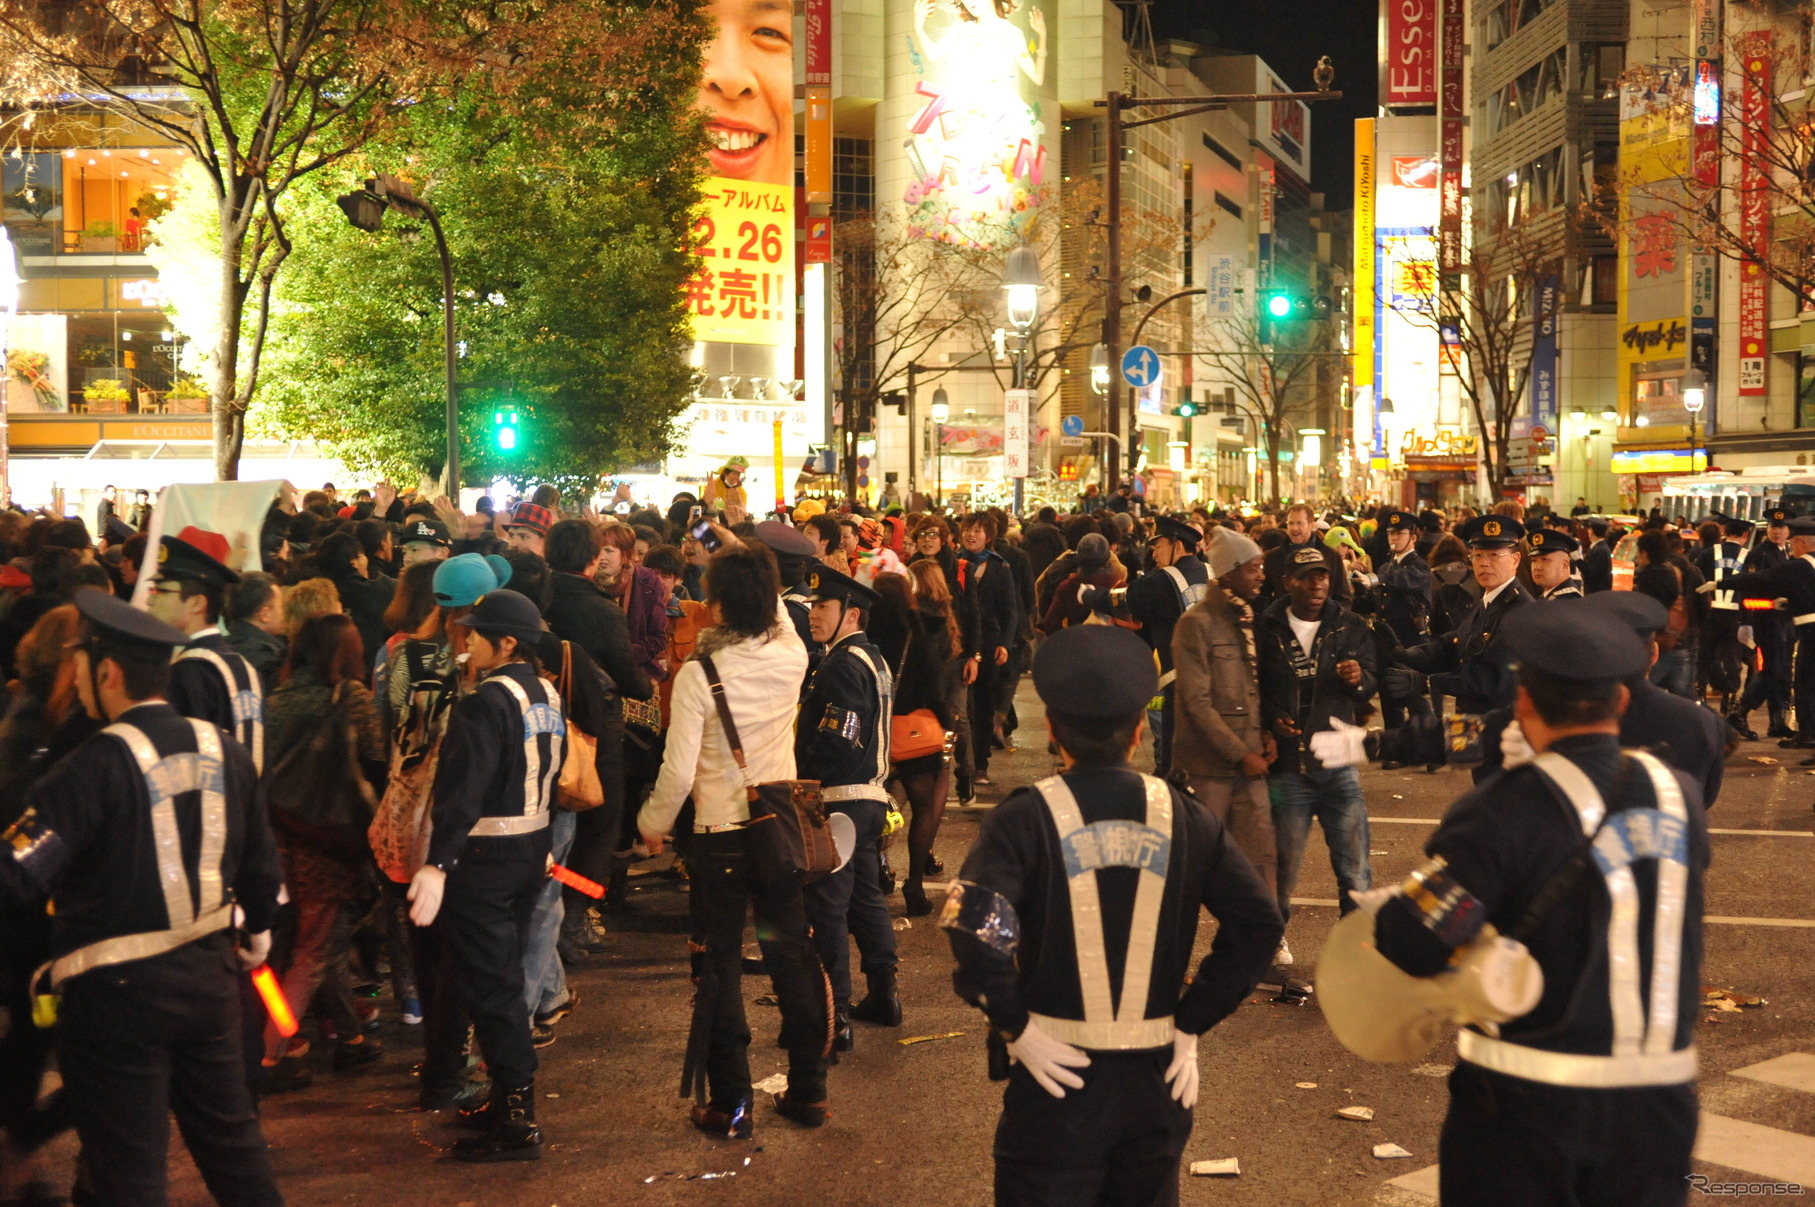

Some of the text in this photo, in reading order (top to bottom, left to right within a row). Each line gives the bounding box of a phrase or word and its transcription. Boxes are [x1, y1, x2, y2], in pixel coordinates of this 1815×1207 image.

[1360, 154, 1370, 199] KiYoshi
[1541, 287, 1552, 335] MIZHO
[1007, 398, 1020, 468] 道玄坂
[1069, 825, 1164, 869] 警視庁
